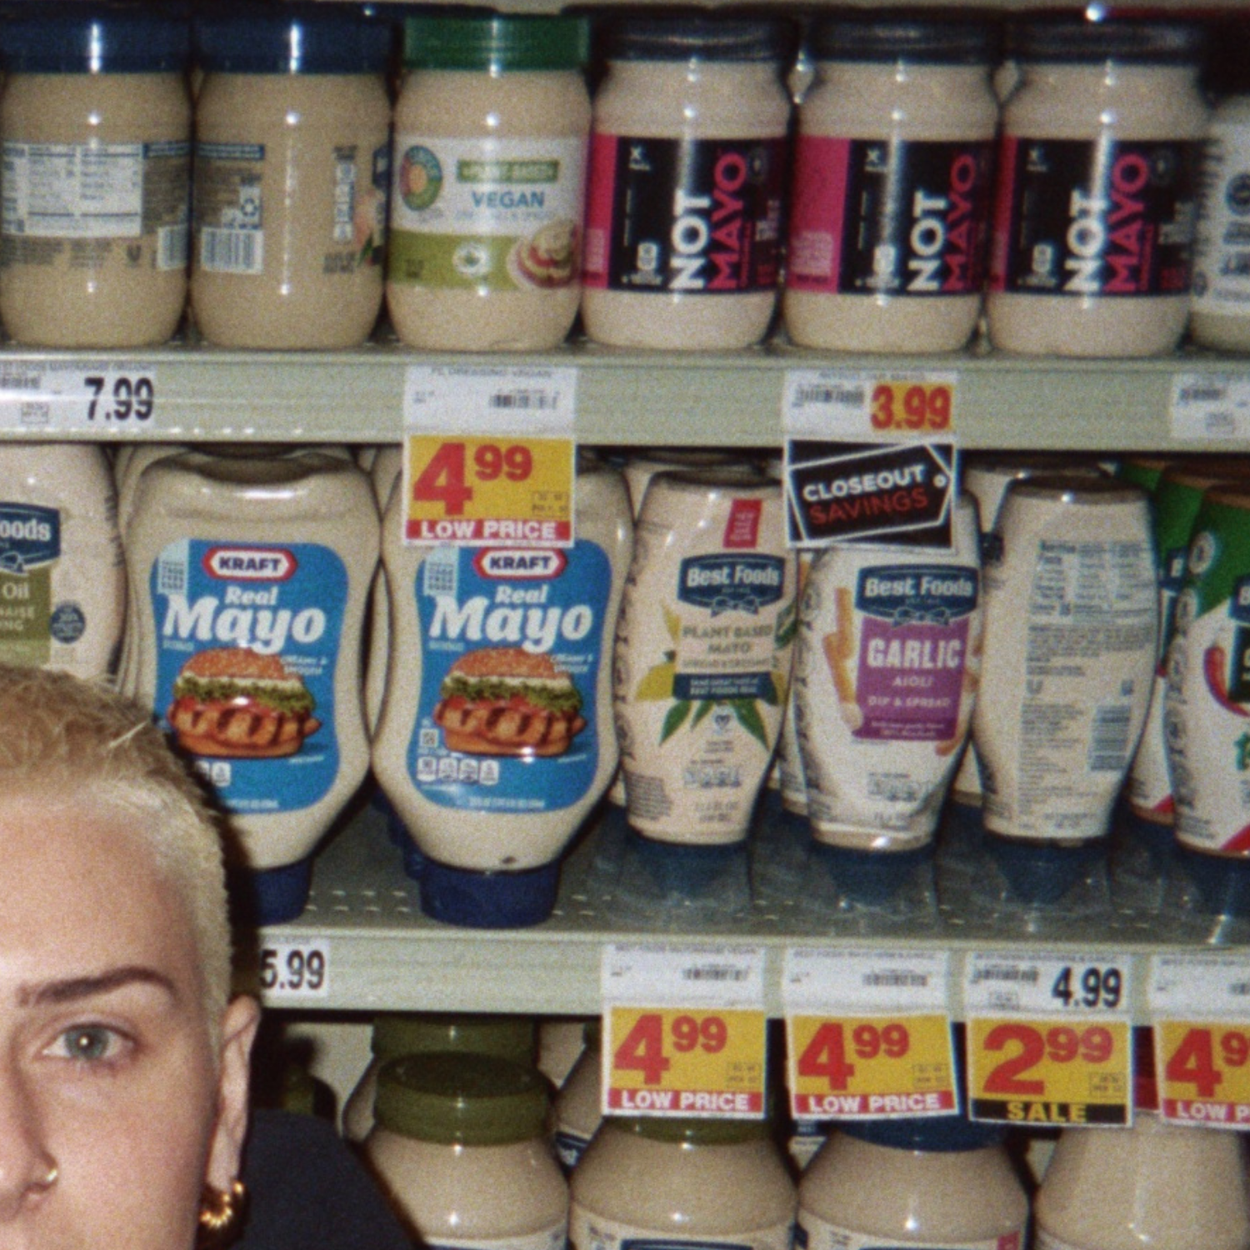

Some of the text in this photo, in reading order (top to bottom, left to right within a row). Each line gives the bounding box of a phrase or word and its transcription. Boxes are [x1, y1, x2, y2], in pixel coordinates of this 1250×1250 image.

[471, 190, 546, 209] VEGAN
[708, 153, 747, 290] MAYO
[941, 154, 977, 292] MAYO
[1103, 153, 1148, 293] MAYO
[668, 189, 711, 290] NOT
[906, 188, 947, 292] NOT
[1062, 188, 1106, 293] NOT
[84, 377, 154, 421] 7.99
[871, 385, 951, 430] 3.99
[803, 464, 926, 502] CLOSEOUT
[809, 487, 928, 525] SAVINGS
[421, 521, 556, 539] LOW PRICE
[219, 556, 282, 573] KRAFT
[489, 556, 552, 570] KRAFT
[686, 565, 780, 588] Best Foods
[3, 581, 30, 599] Oil
[224, 585, 279, 607] Real
[495, 584, 548, 604] Real
[864, 576, 973, 598] Best Foods
[162, 593, 327, 655] Mayo
[429, 595, 593, 654] Mayo
[682, 625, 730, 638] PLANT
[867, 638, 962, 669] GARLIC
[892, 675, 934, 687] AIOLI
[260, 949, 326, 989] 5.99
[1051, 967, 1122, 1008] 4.99
[622, 1091, 749, 1110] LOW PRICE
[808, 1093, 941, 1112] LOW PRICE
[1007, 1102, 1087, 1123] SALE
[1176, 1102, 1234, 1121] LOW
